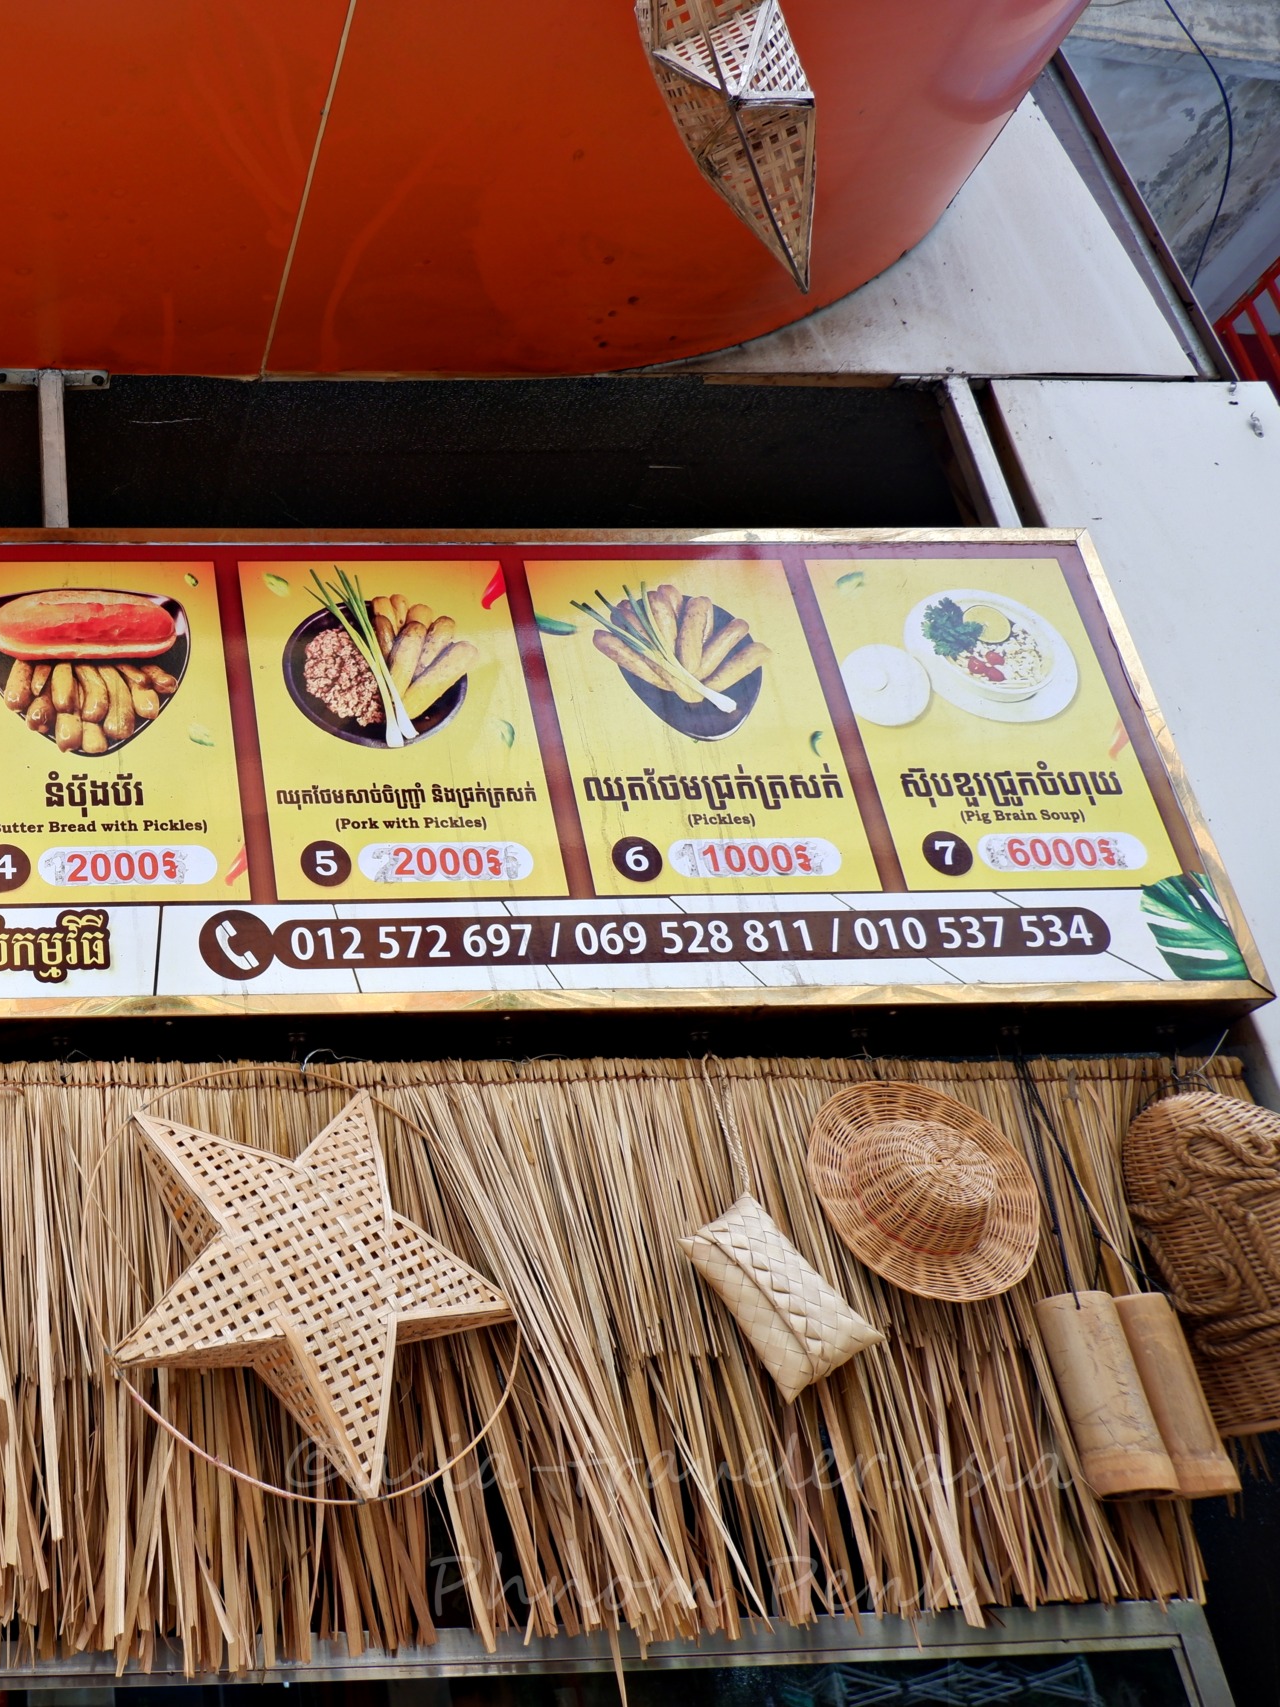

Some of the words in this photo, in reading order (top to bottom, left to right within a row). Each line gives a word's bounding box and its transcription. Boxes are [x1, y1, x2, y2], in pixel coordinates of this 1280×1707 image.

[48, 821, 97, 833] Bread
[101, 820, 138, 832] with
[143, 819, 208, 834] Pickles)
[335, 818, 379, 832] (Pork
[383, 817, 420, 829] with
[423, 816, 487, 831] Pickles)
[687, 813, 756, 828] (Pickles)
[960, 810, 992, 825] (Pig
[995, 809, 1037, 822] Brain
[1041, 809, 1086, 824] Soup)
[315, 850, 338, 876] 5
[625, 846, 650, 871] 6
[934, 841, 956, 866] 7
[291, 925, 362, 962] 012
[379, 923, 450, 960] 572
[463, 921, 533, 958] 697
[575, 920, 647, 956] 069
[662, 919, 733, 955] 528
[745, 918, 814, 953] 811
[854, 916, 927, 952] 010
[939, 915, 1005, 950] 537
[1021, 913, 1093, 948] 534
